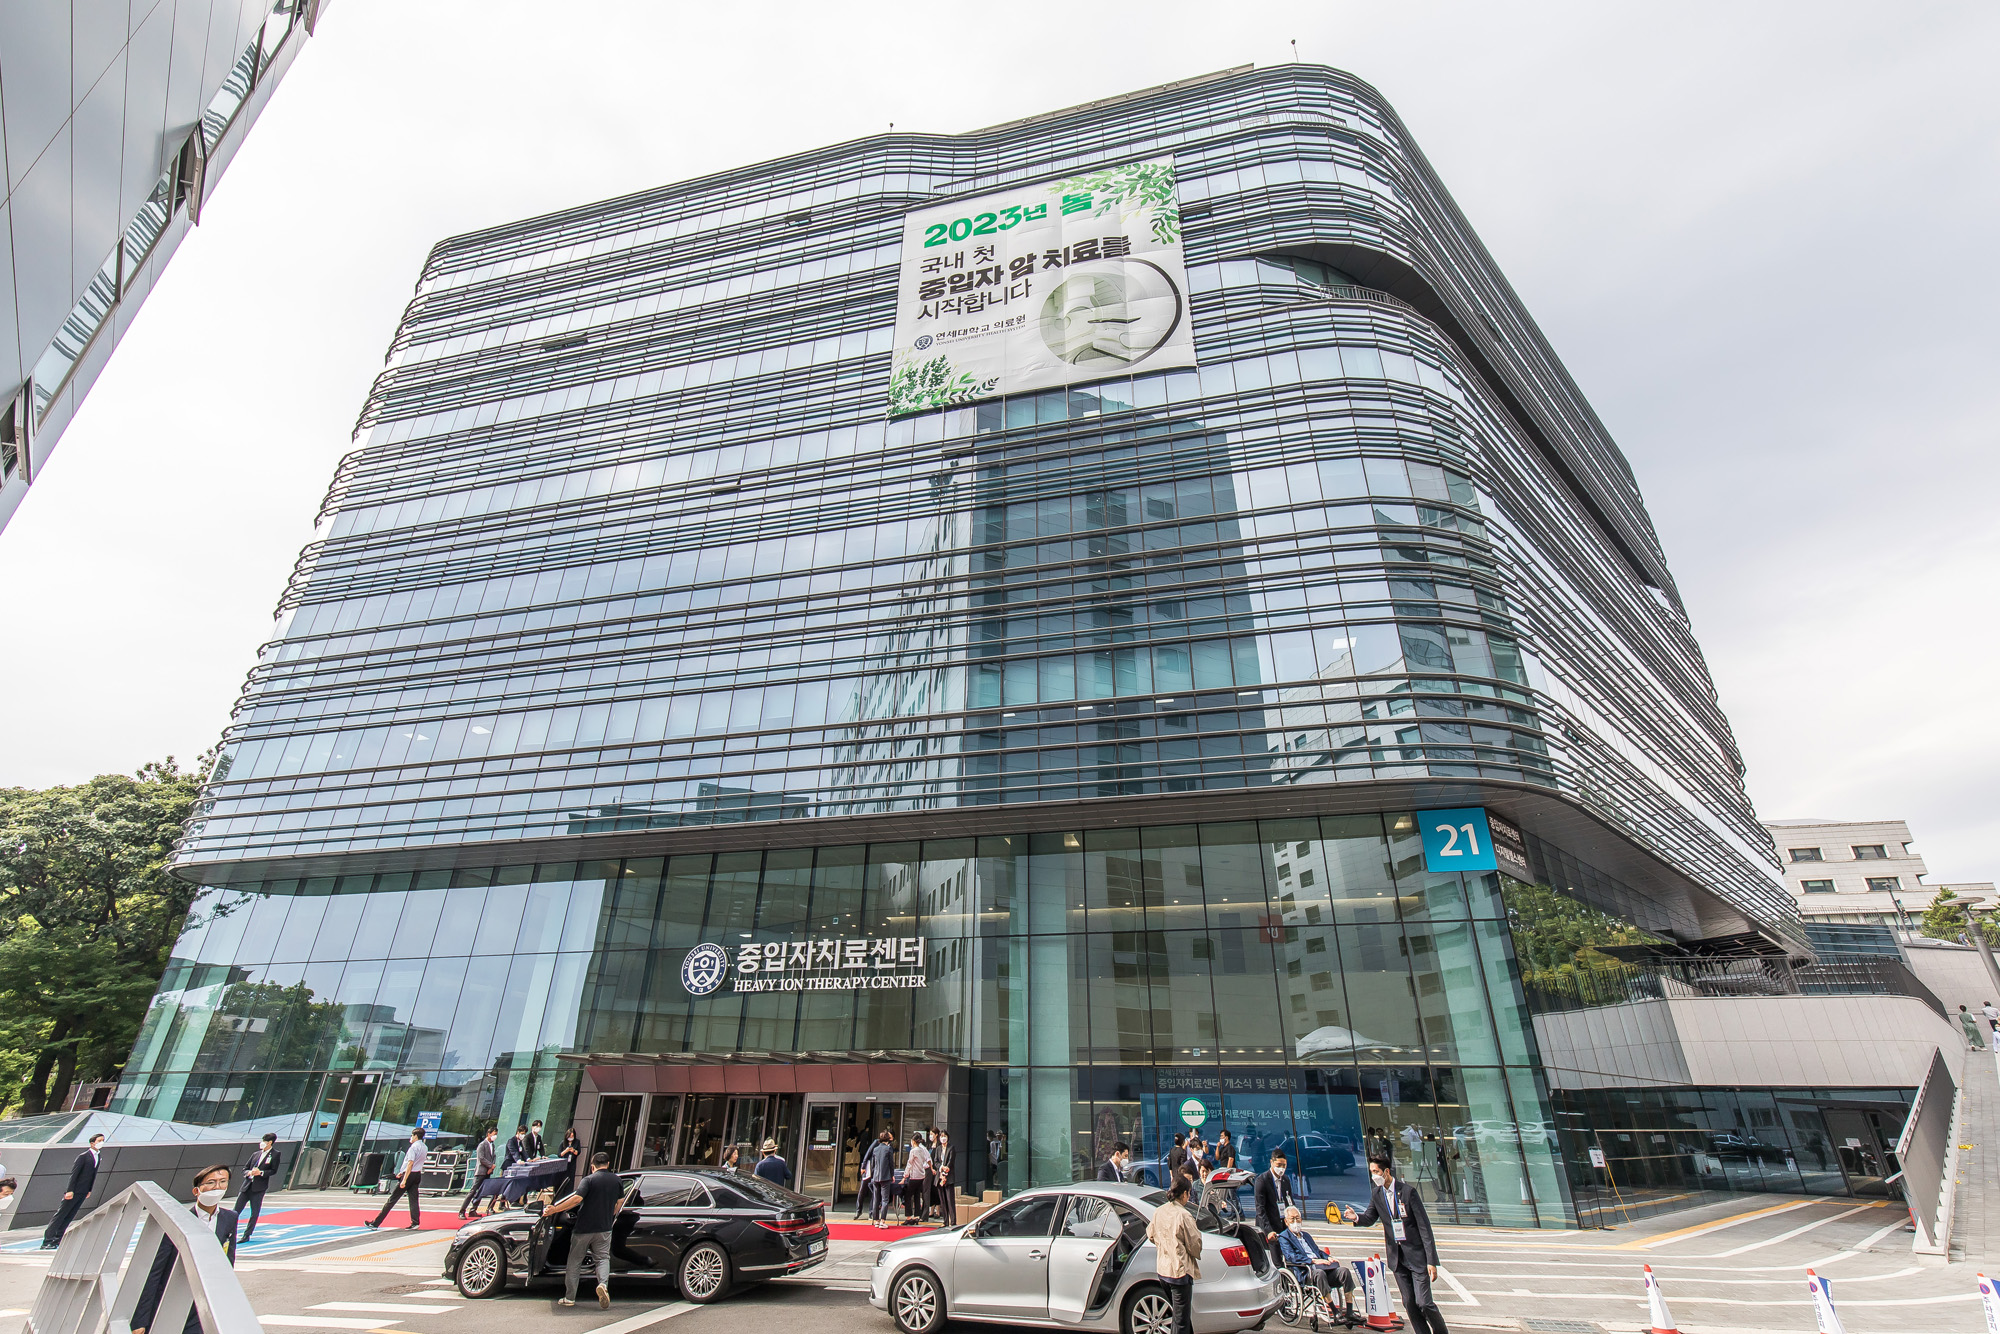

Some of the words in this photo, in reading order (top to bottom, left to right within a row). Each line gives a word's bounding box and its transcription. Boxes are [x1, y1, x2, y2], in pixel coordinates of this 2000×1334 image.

[924, 203, 1047, 248] 2023년
[1060, 191, 1094, 216] 봄
[919, 264, 1004, 301] 중입자
[1009, 252, 1037, 281] 암
[1042, 235, 1131, 270] 치료를
[920, 251, 965, 274] 국내
[973, 244, 995, 265] 첫
[917, 278, 1032, 319] 시작합니다
[935, 324, 990, 340] 연세대학교
[993, 314, 1026, 329] 의료원
[1435, 823, 1480, 857] 21
[684, 949, 700, 970] YONSEI
[701, 945, 725, 968] UNIVERSITY
[736, 937, 925, 973] 중입자치료센터
[733, 978, 777, 993] HEAVY
[779, 977, 803, 992] ION
[805, 975, 870, 991] THERAPY
[870, 974, 927, 989] CENTER
[1158, 1078, 1220, 1089] 중입자치료센터
[1225, 1078, 1251, 1089] 개소식
[1256, 1078, 1266, 1089] 및
[1269, 1078, 1298, 1089] 봉헌식
[421, 1118, 429, 1128] P
[1257, 1109, 1280, 1119] 개소식
[1283, 1109, 1291, 1120] 및
[1293, 1109, 1317, 1120] 봉헌식
[1369, 1280, 1377, 1312] 주차금지
